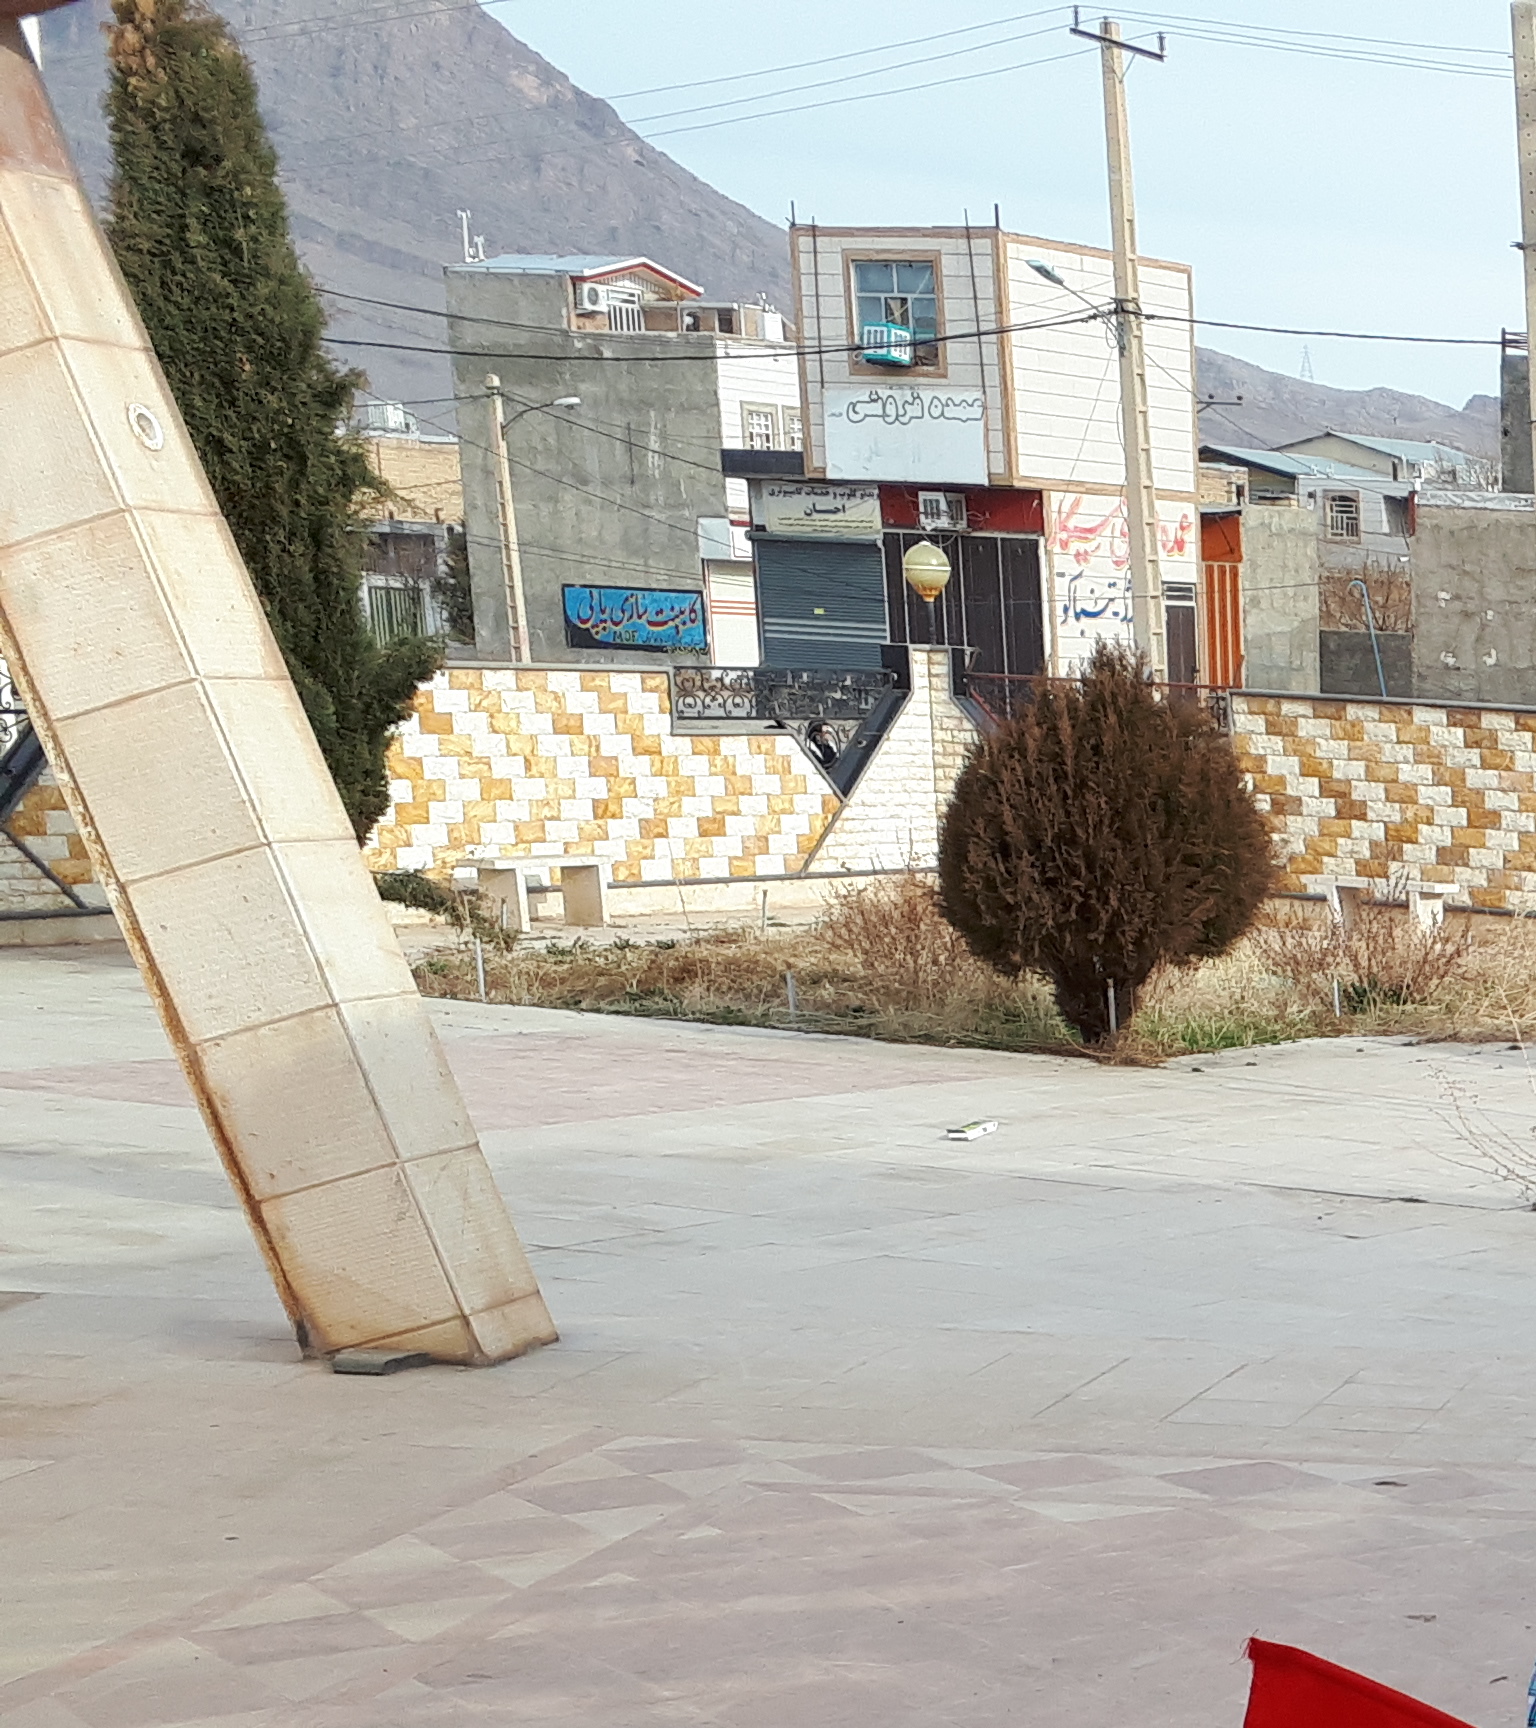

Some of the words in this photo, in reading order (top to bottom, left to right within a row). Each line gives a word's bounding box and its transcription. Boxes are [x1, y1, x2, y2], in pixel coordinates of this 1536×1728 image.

[928, 395, 984, 423] عمده
[610, 592, 649, 628] سازی
[647, 594, 701, 636] کابینت
